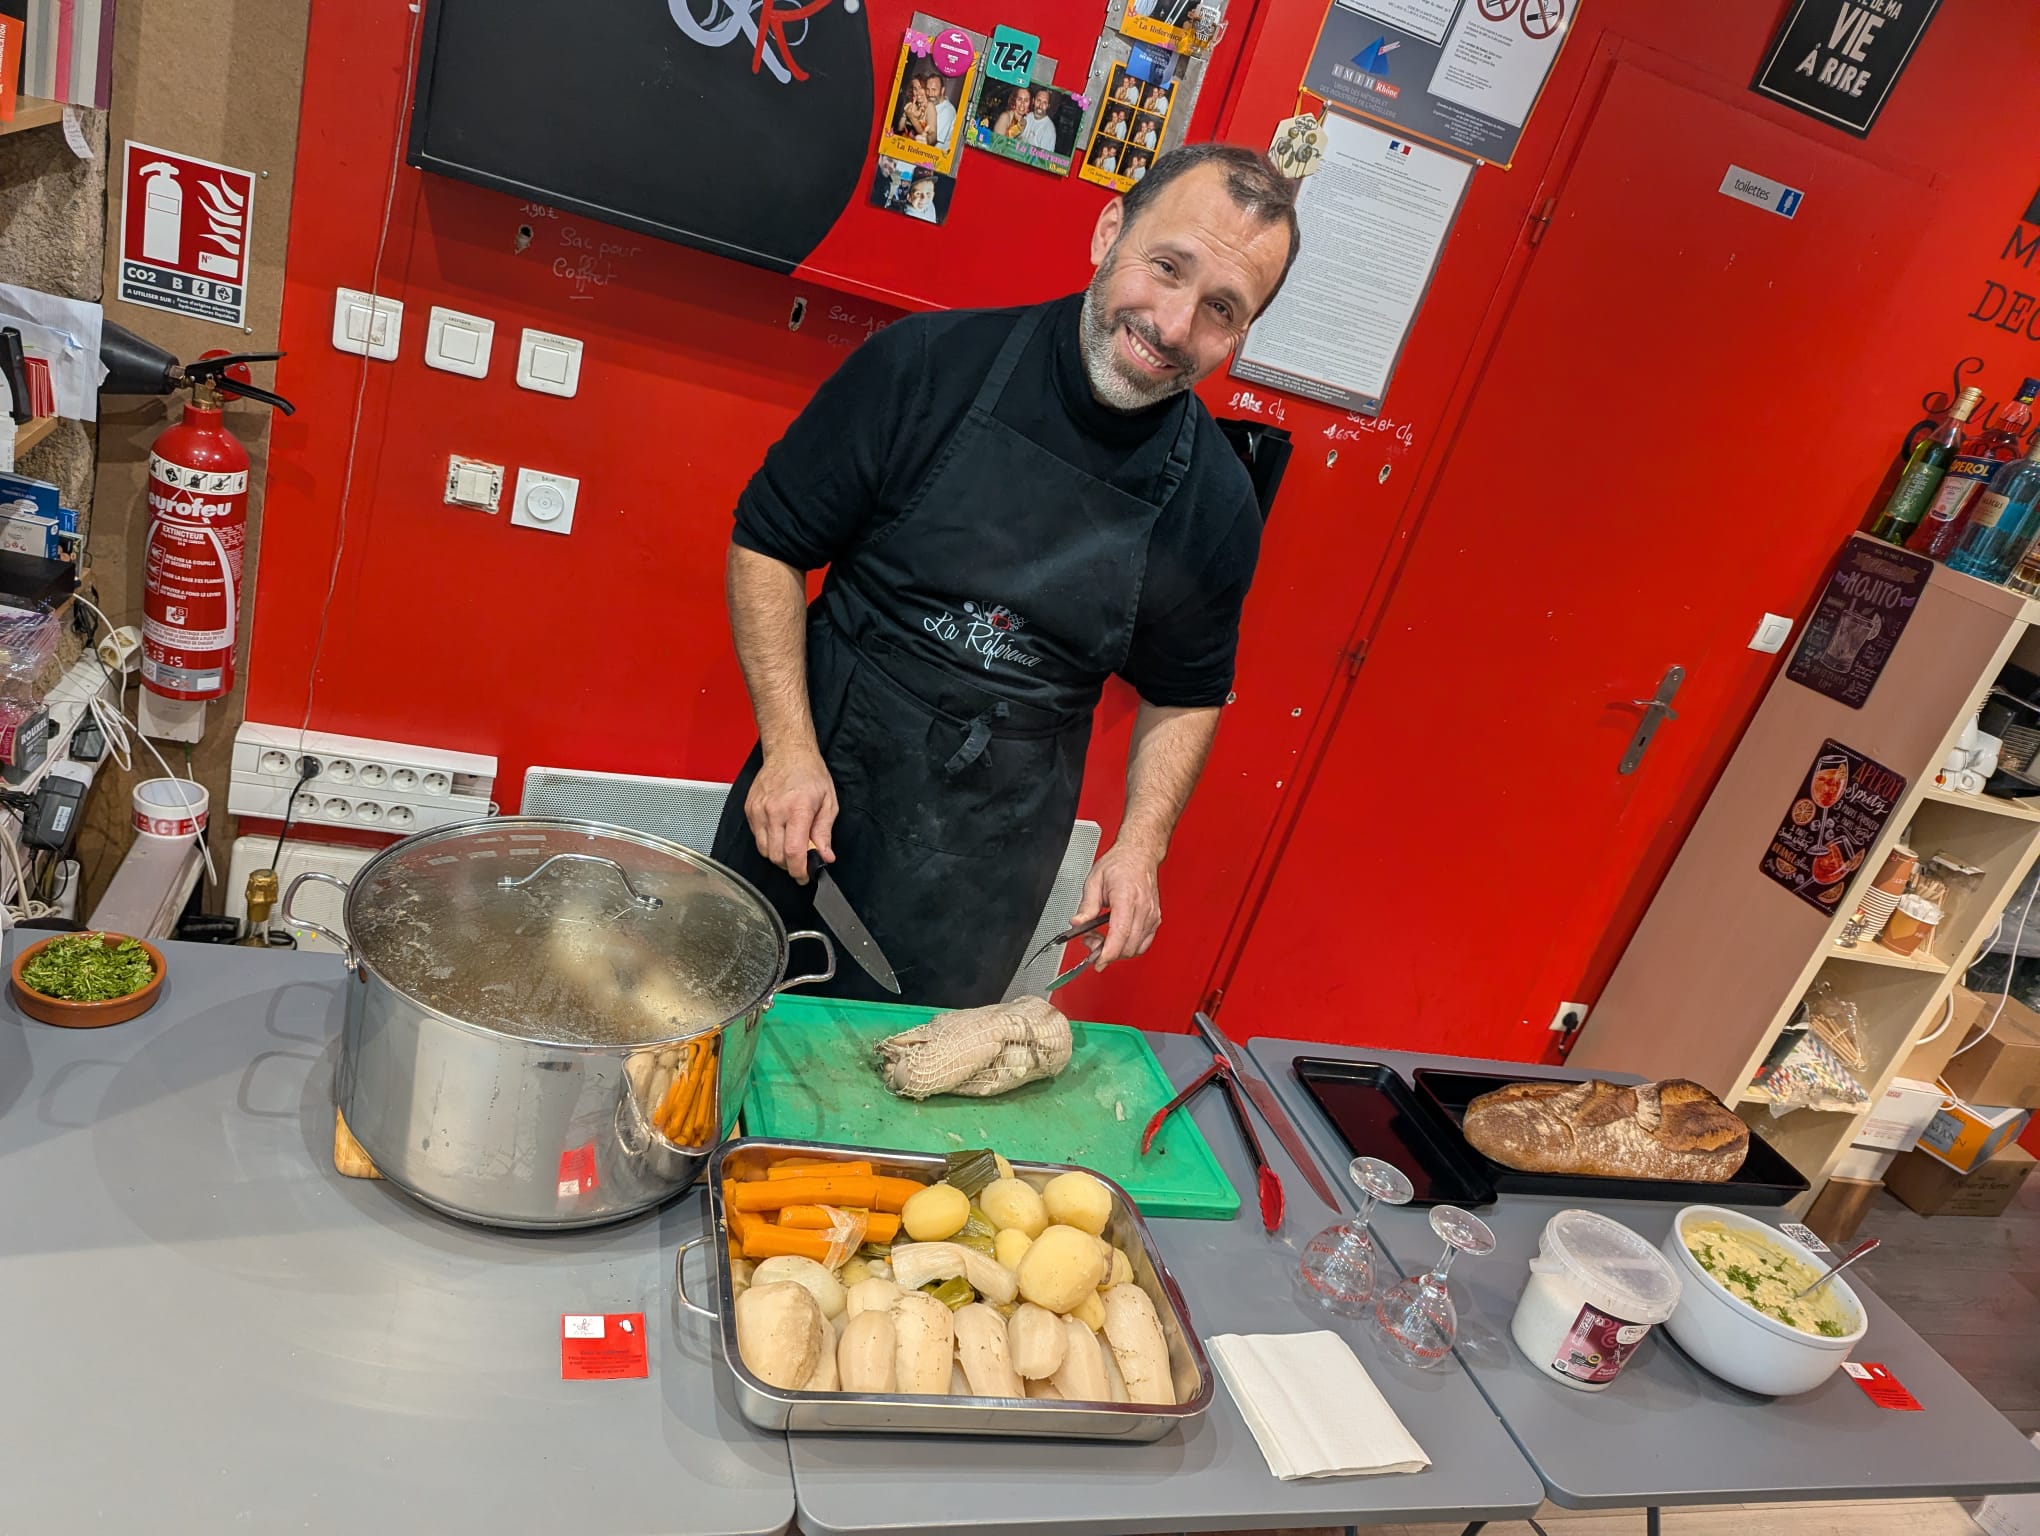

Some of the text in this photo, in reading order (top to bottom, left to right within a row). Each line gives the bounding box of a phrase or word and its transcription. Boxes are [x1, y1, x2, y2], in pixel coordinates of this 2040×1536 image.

[1886, 1, 1903, 20] MA
[1828, 2, 1885, 62] VIE
[992, 41, 1033, 74] TEA
[1376, 80, 1399, 98] Rhône
[1818, 57, 1871, 98] RIRE
[1734, 177, 1770, 201] toilettes
[560, 226, 643, 259] Sac pour
[126, 267, 183, 290] CO2 B
[133, 289, 159, 301] UTILISER
[828, 305, 857, 324] Sac
[148, 492, 232, 518] eurofeu
[162, 525, 204, 541] EXTINCTEUR
[1843, 570, 1902, 609] MOJITO
[923, 611, 1043, 670] La Référence
[21, 718, 49, 745] ROUXEL
[1852, 761, 1903, 802] APEROL
[1844, 782, 1889, 816] Spritz
[1771, 843, 1798, 863] ORANGE
